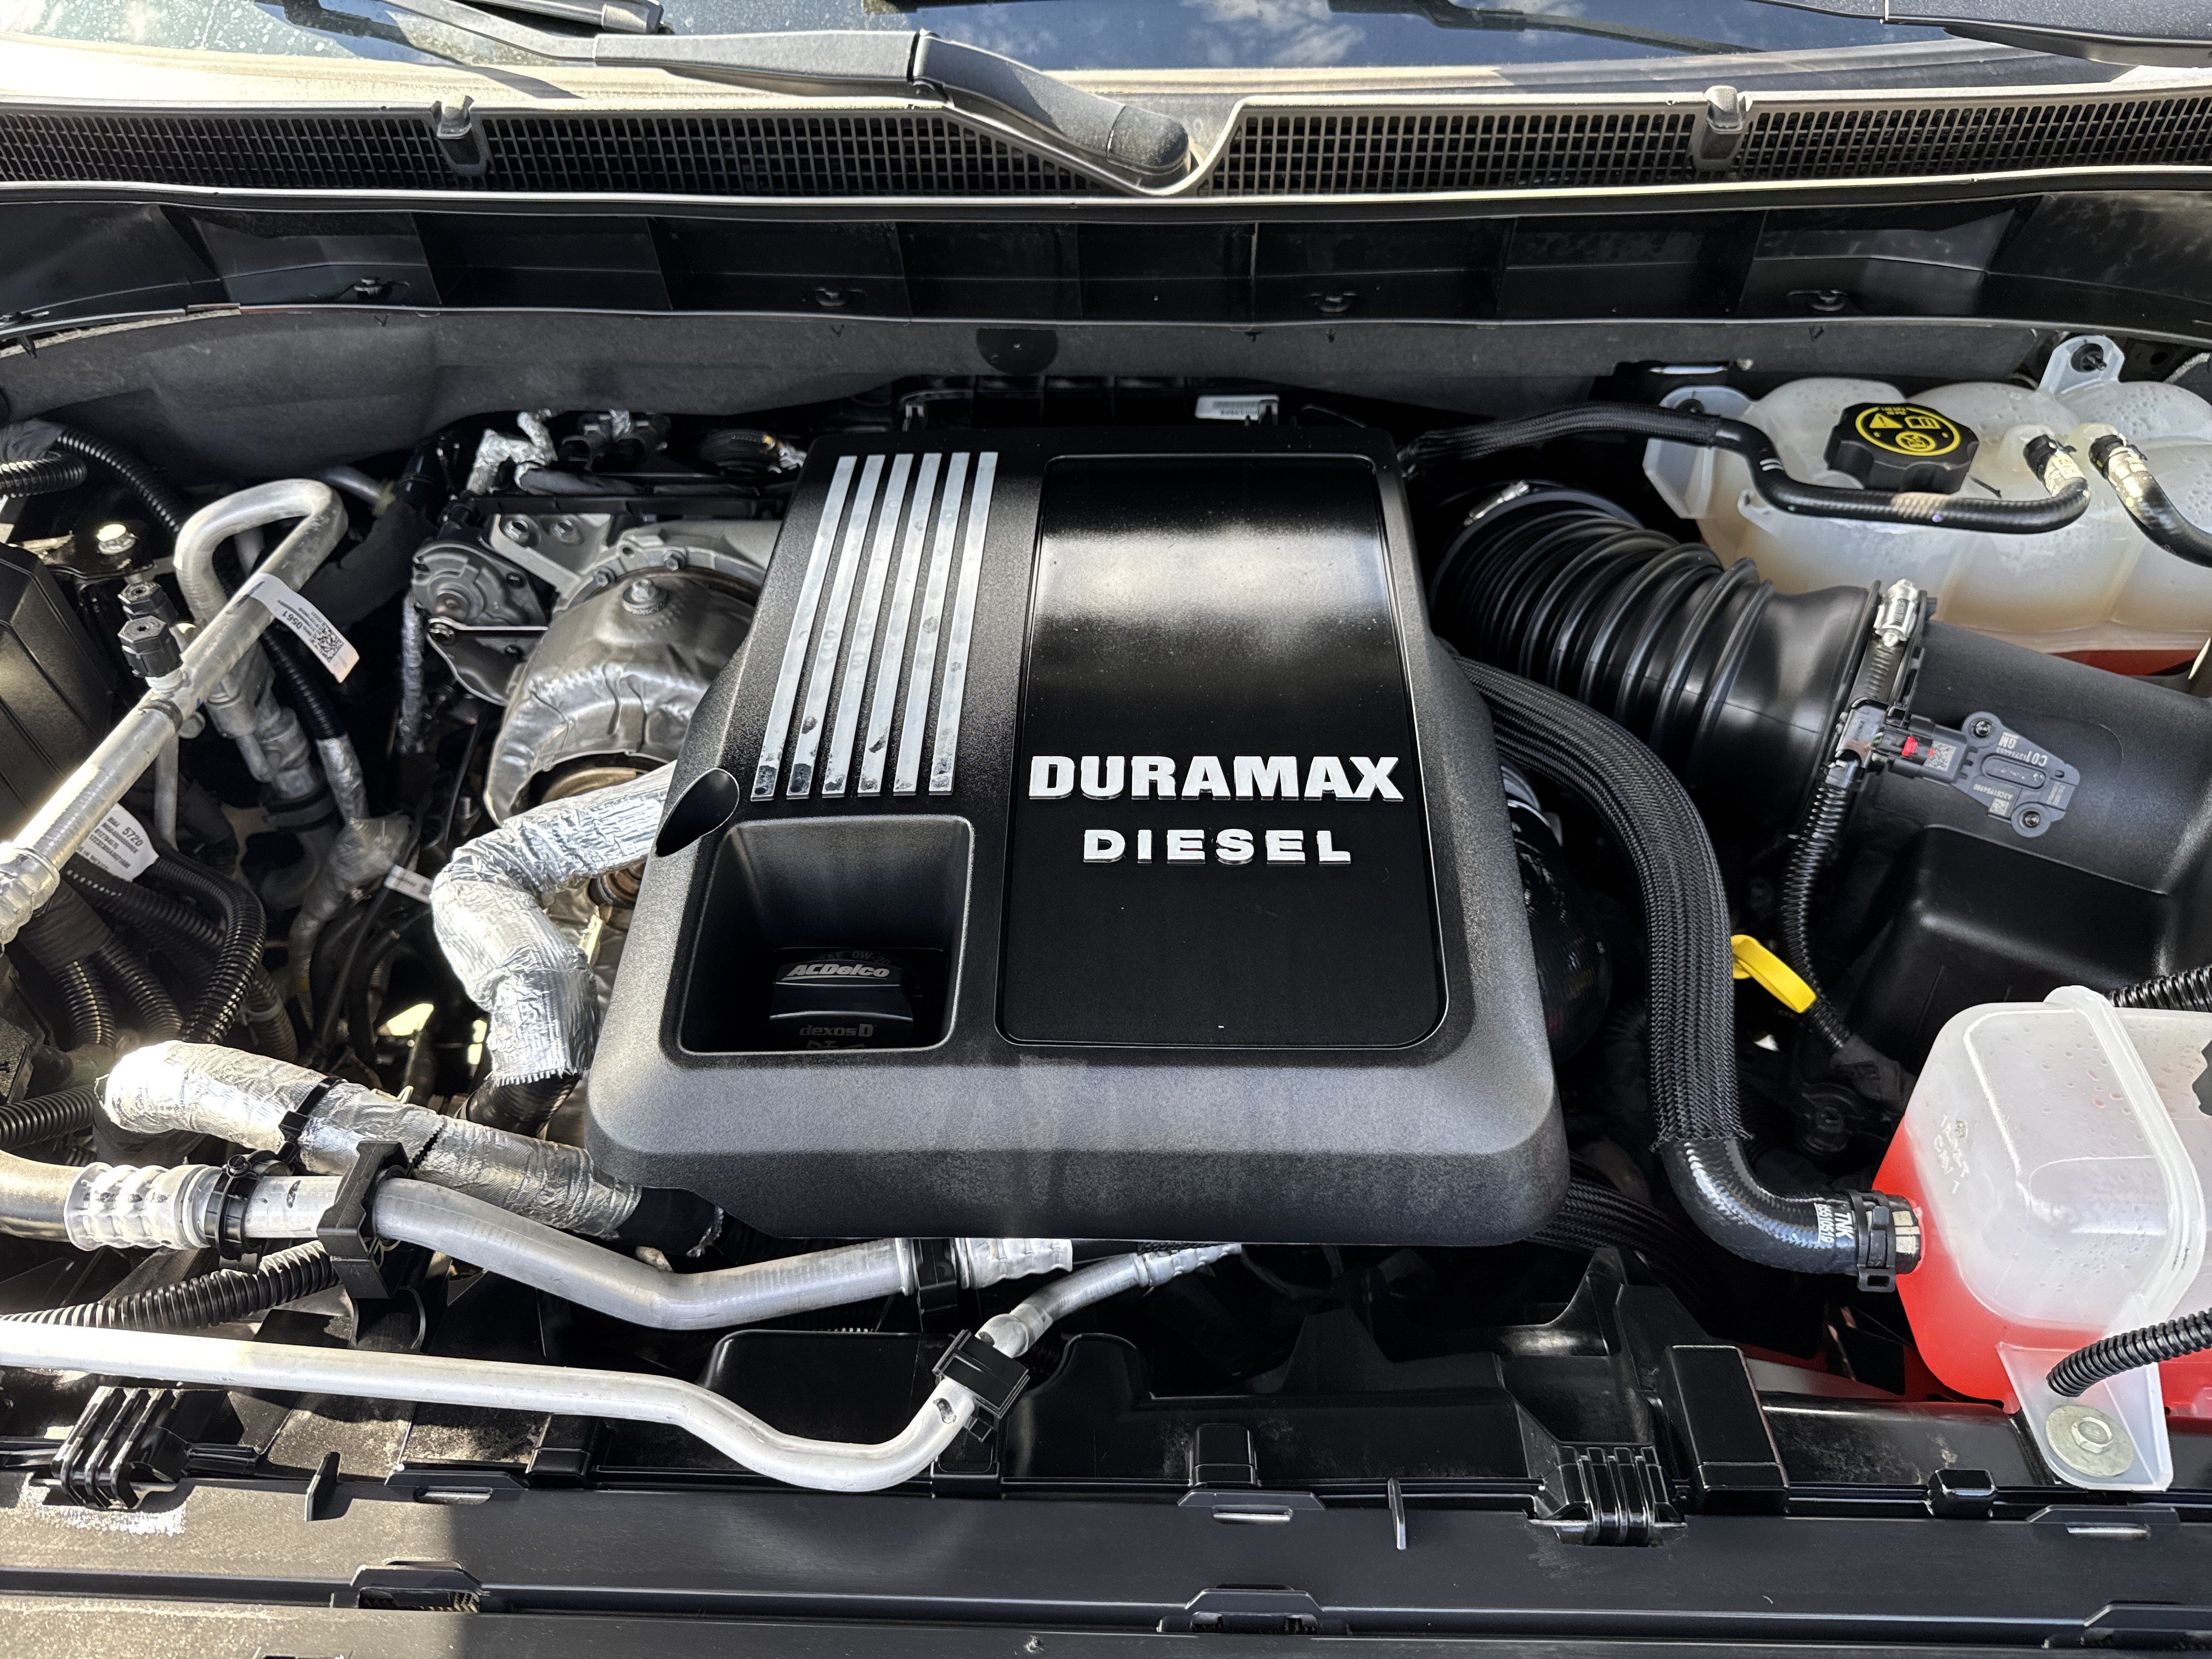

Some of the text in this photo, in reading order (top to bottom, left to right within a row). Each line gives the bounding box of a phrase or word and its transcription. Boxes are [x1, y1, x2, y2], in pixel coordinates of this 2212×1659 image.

[282, 611, 303, 629] 0561
[1997, 735, 2017, 749] GM
[1028, 755, 1405, 803] DURAMAX
[122, 827, 144, 847] 5720
[1082, 829, 1352, 865] DIESEL
[786, 963, 890, 978] ACDelco
[1834, 1212, 1854, 1240] TNK
